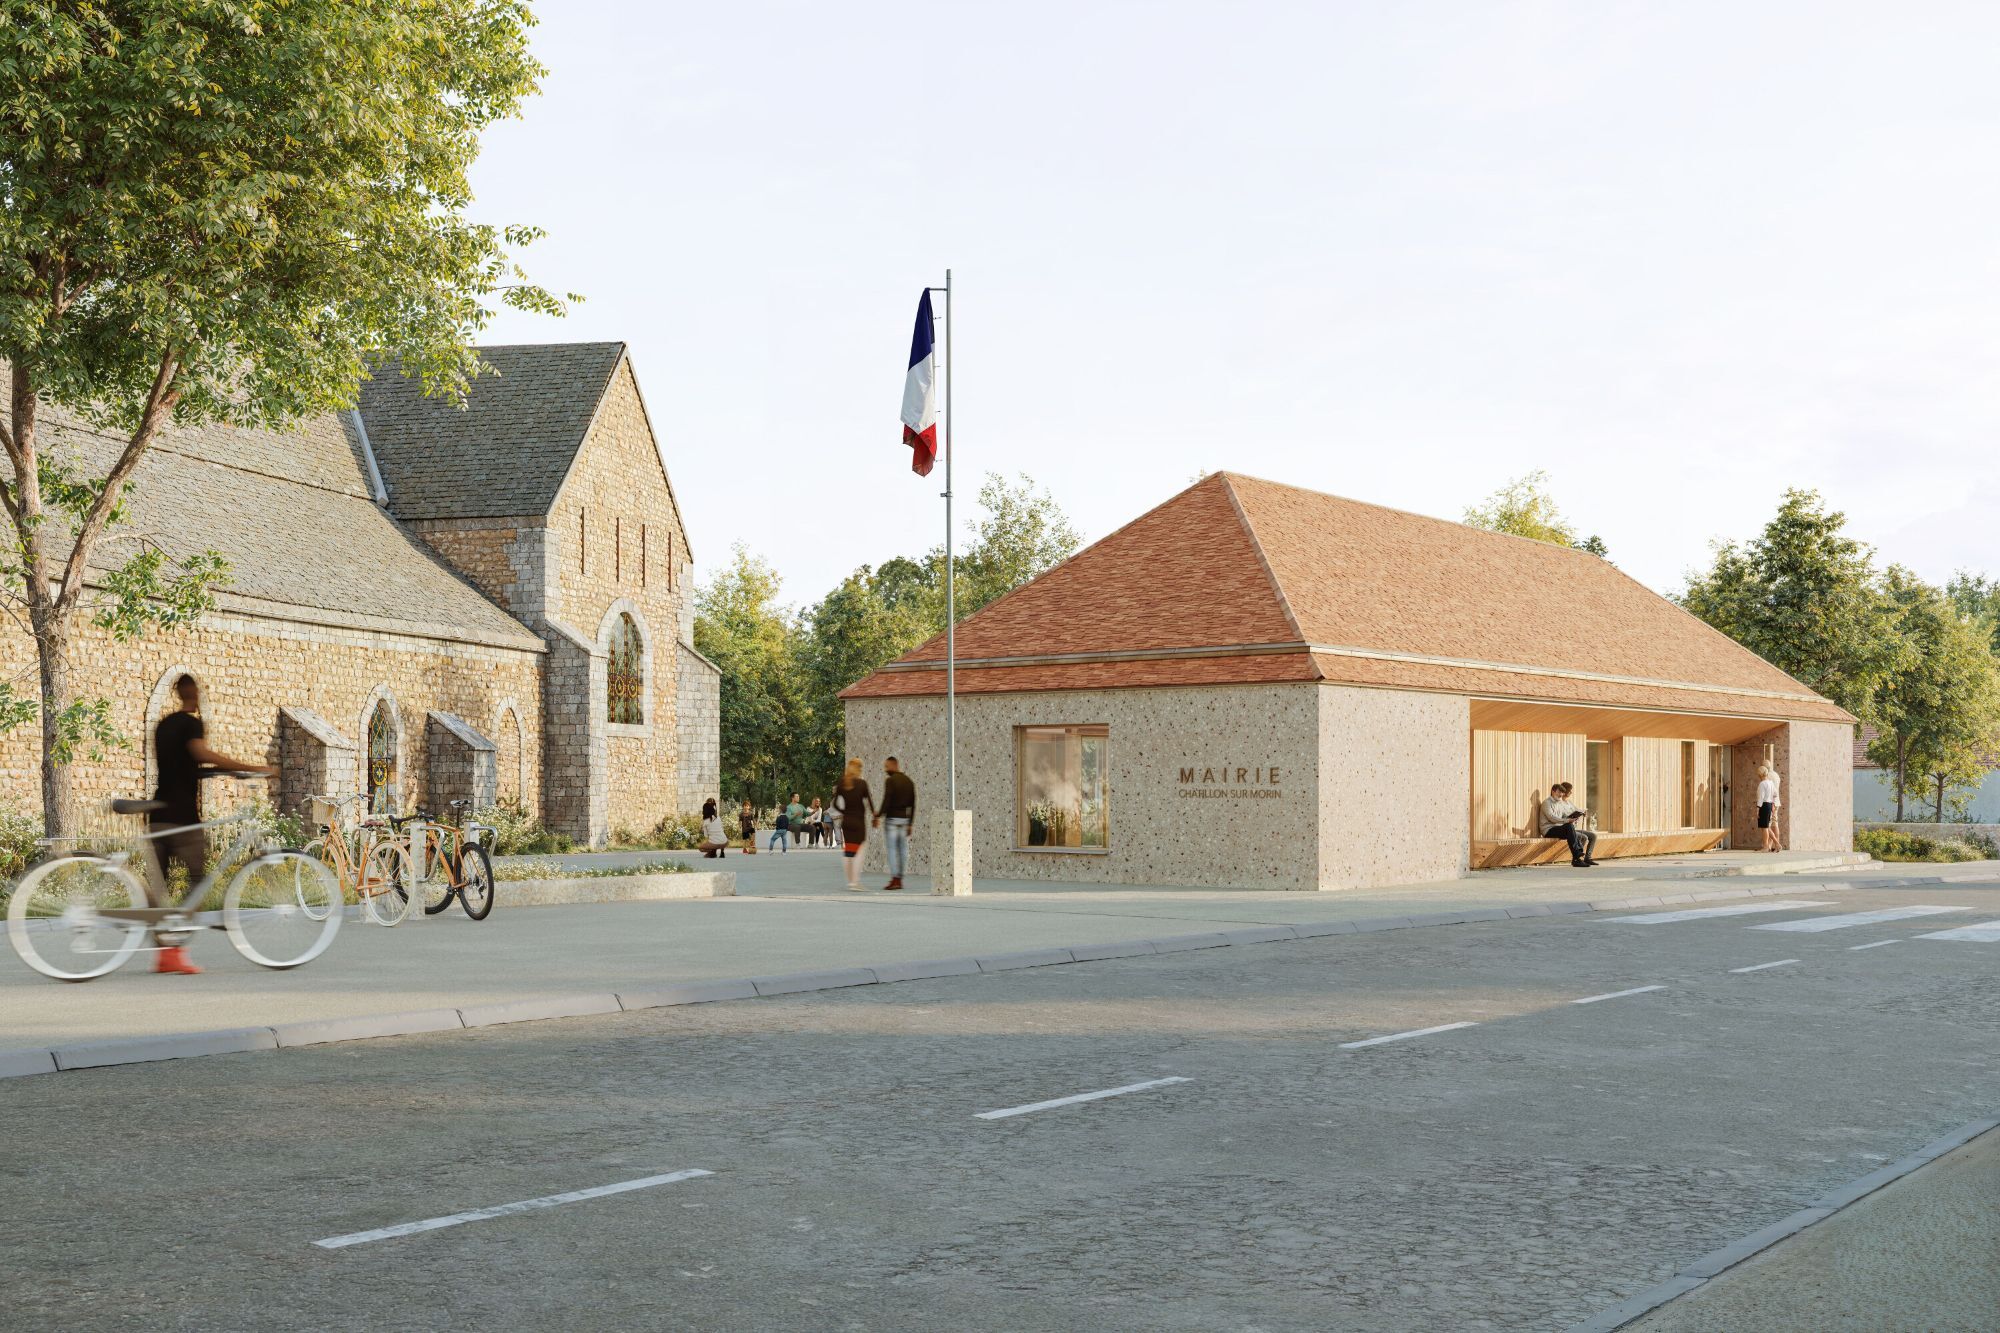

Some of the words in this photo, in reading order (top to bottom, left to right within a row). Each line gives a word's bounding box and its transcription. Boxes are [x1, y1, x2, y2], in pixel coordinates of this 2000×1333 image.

[1180, 767, 1280, 784] MAIRIE
[1230, 789, 1248, 799] SUR
[1250, 789, 1282, 799] MORIN
